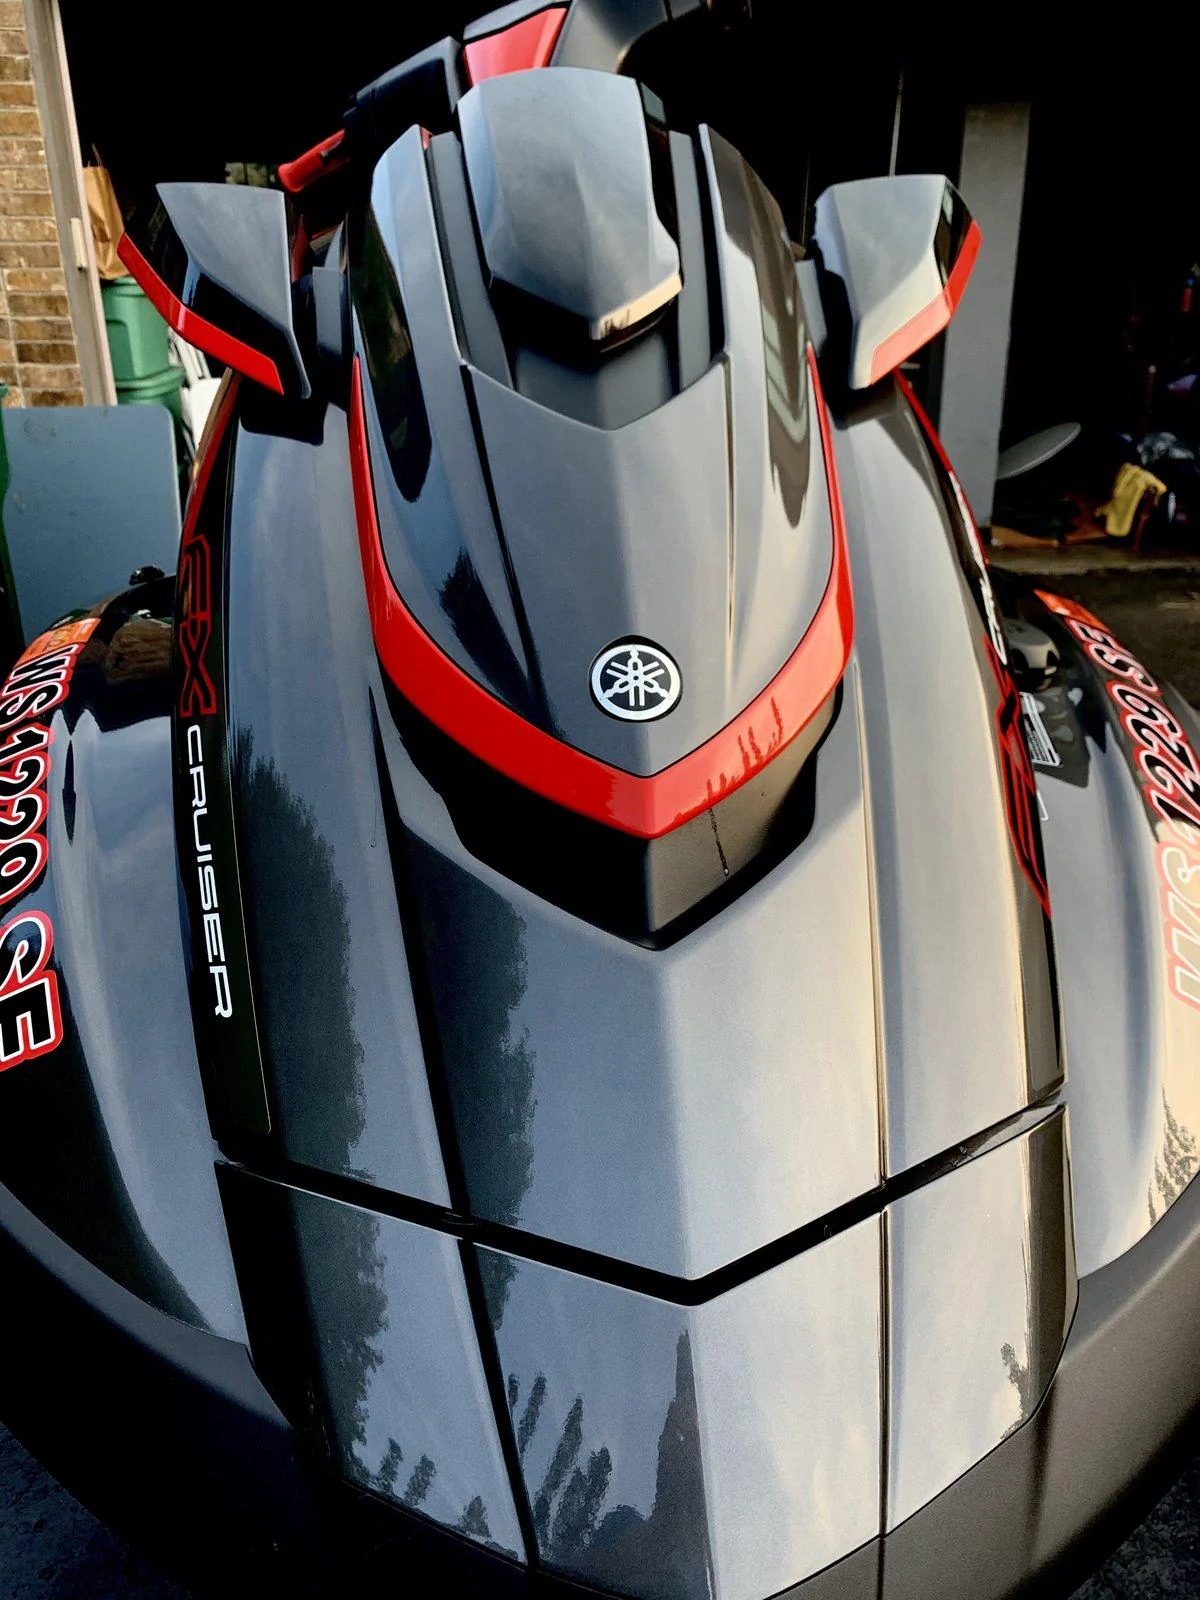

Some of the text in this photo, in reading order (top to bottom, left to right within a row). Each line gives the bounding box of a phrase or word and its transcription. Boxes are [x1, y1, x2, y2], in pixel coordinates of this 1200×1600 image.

[0, 642, 82, 732] WS
[1108, 681, 1200, 842] 1229
[0, 725, 51, 899] 1229
[187, 723, 233, 1019] CRUISER
[0, 911, 61, 1068] SE
